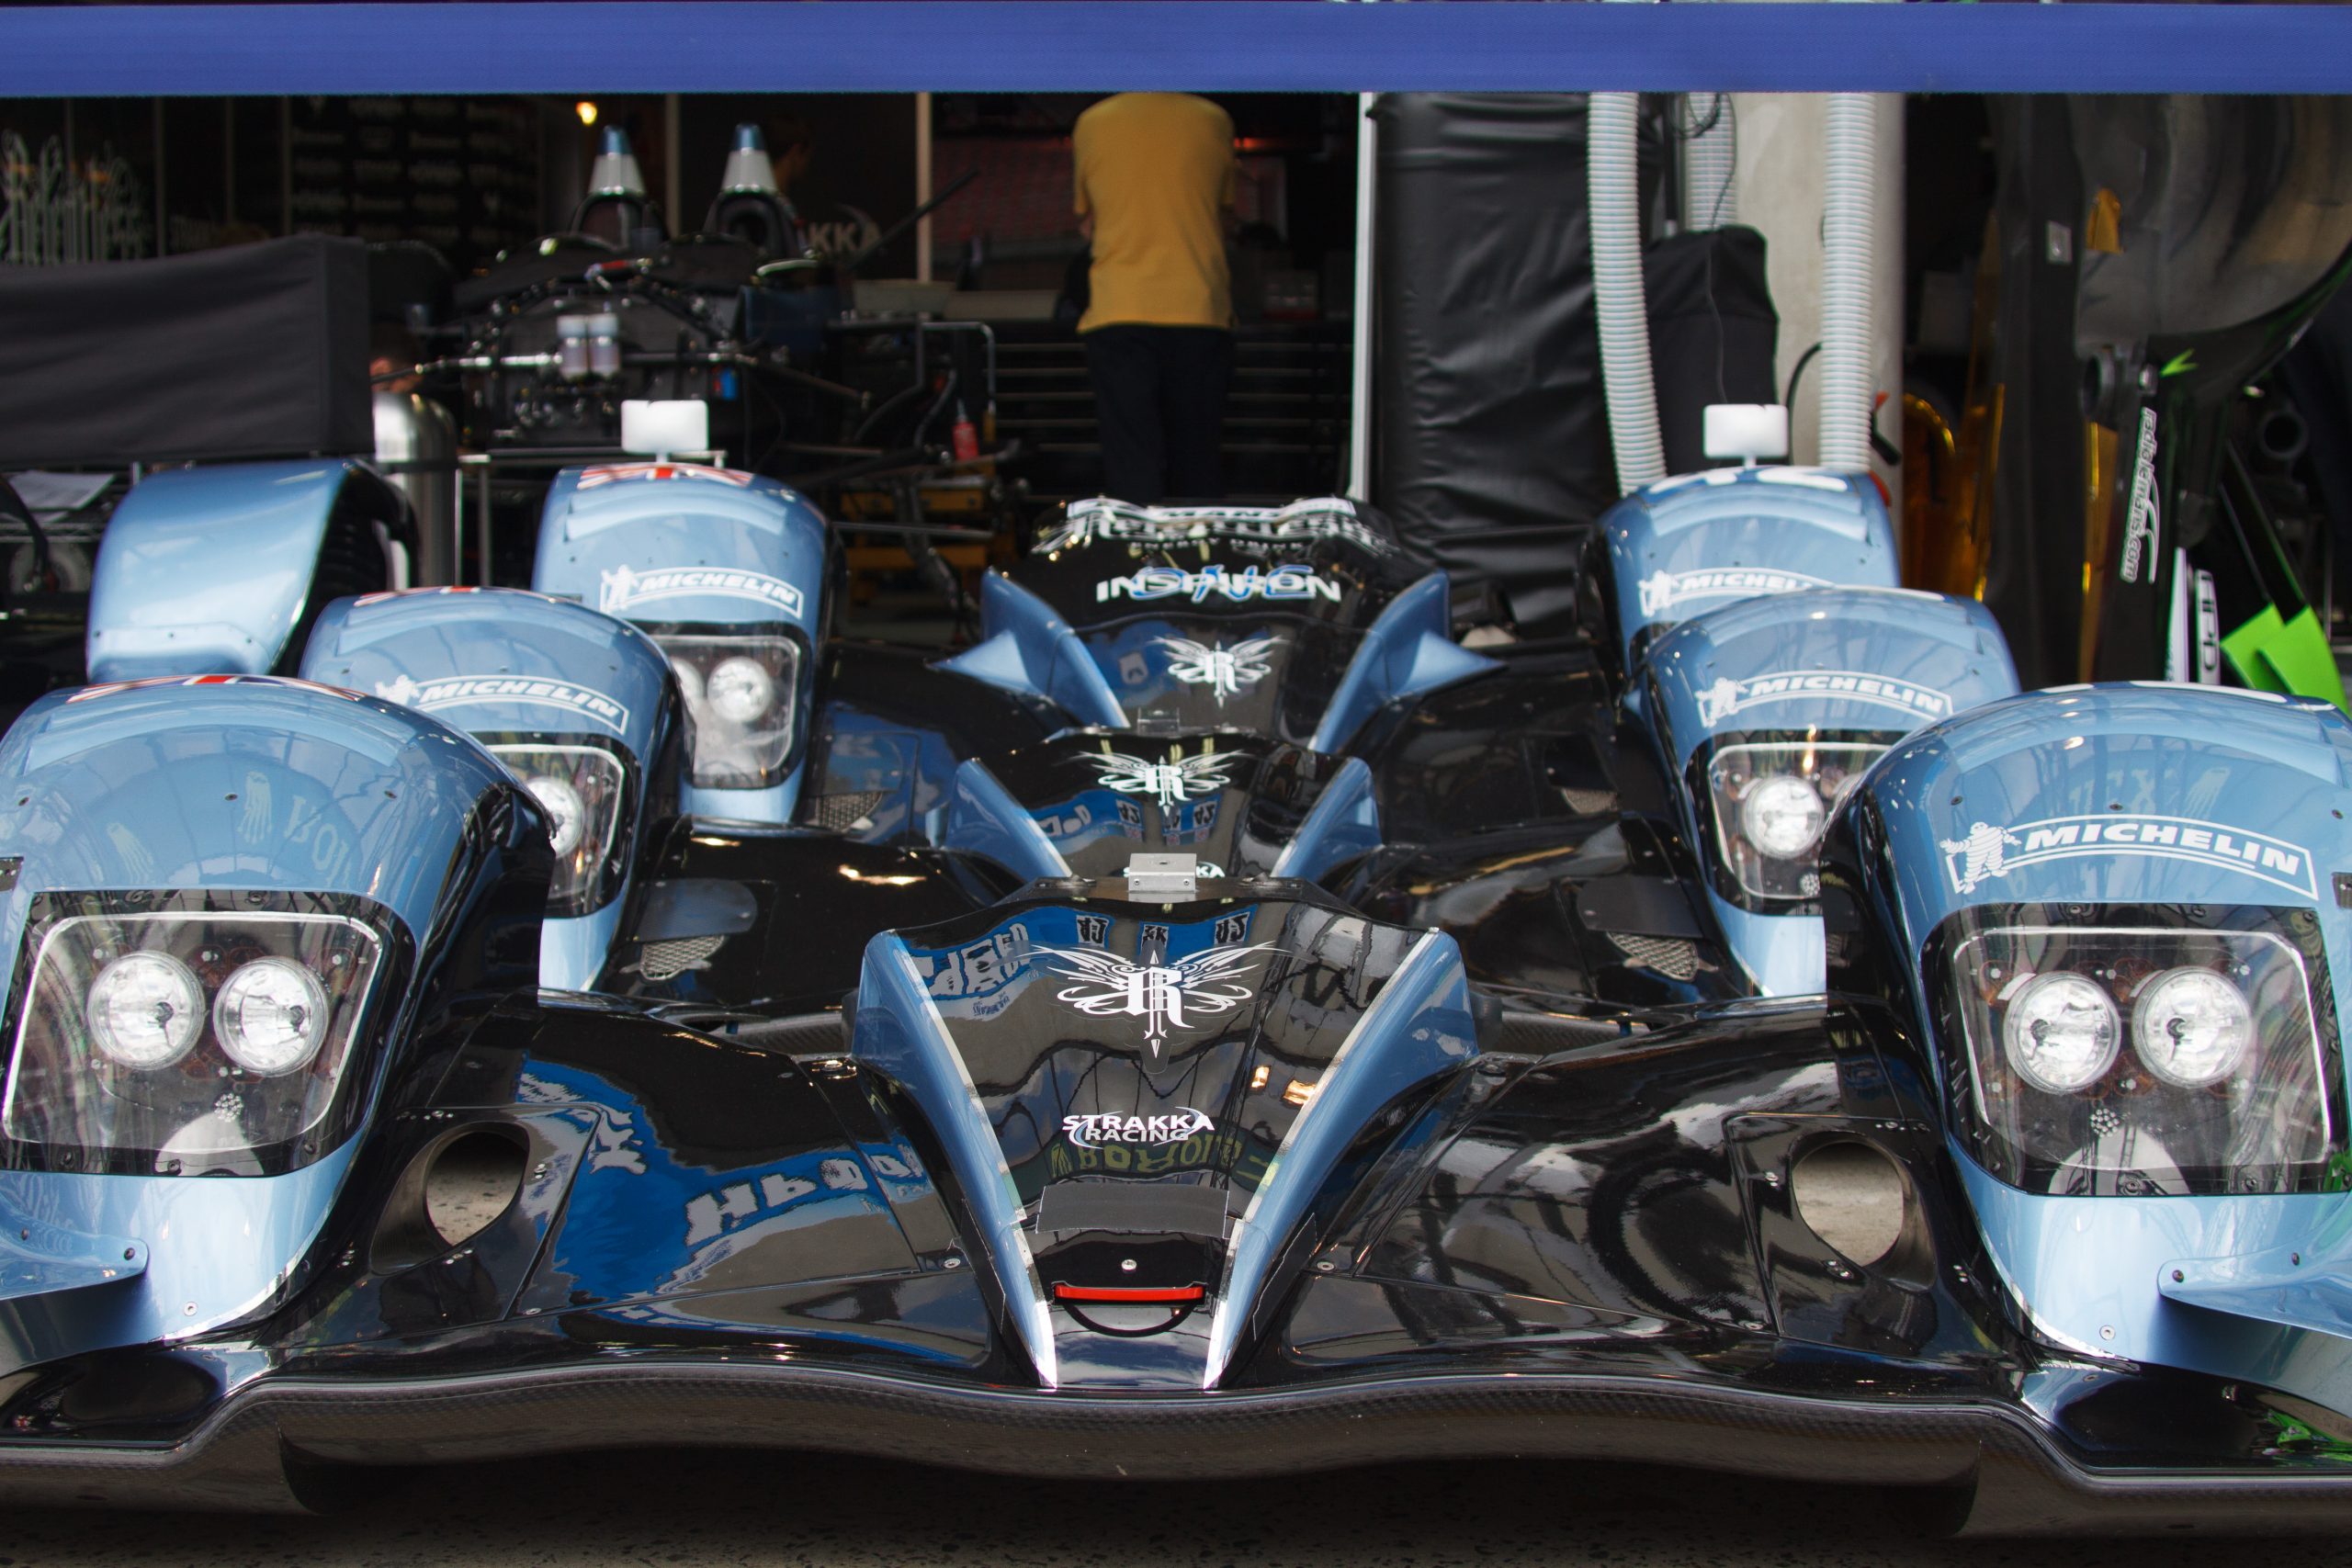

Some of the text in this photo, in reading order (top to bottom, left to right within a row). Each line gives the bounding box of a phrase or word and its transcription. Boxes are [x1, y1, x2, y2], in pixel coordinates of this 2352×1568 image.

[639, 571, 797, 605] MICHELIN
[1680, 571, 1813, 591] MICHEL
[419, 680, 620, 718] MICHELIN
[1748, 674, 1945, 714] MICHELIN
[2024, 823, 2300, 876] MICHELIN
[1062, 1114, 1215, 1132] STRAKKA
[1085, 1129, 1190, 1143] RACING
